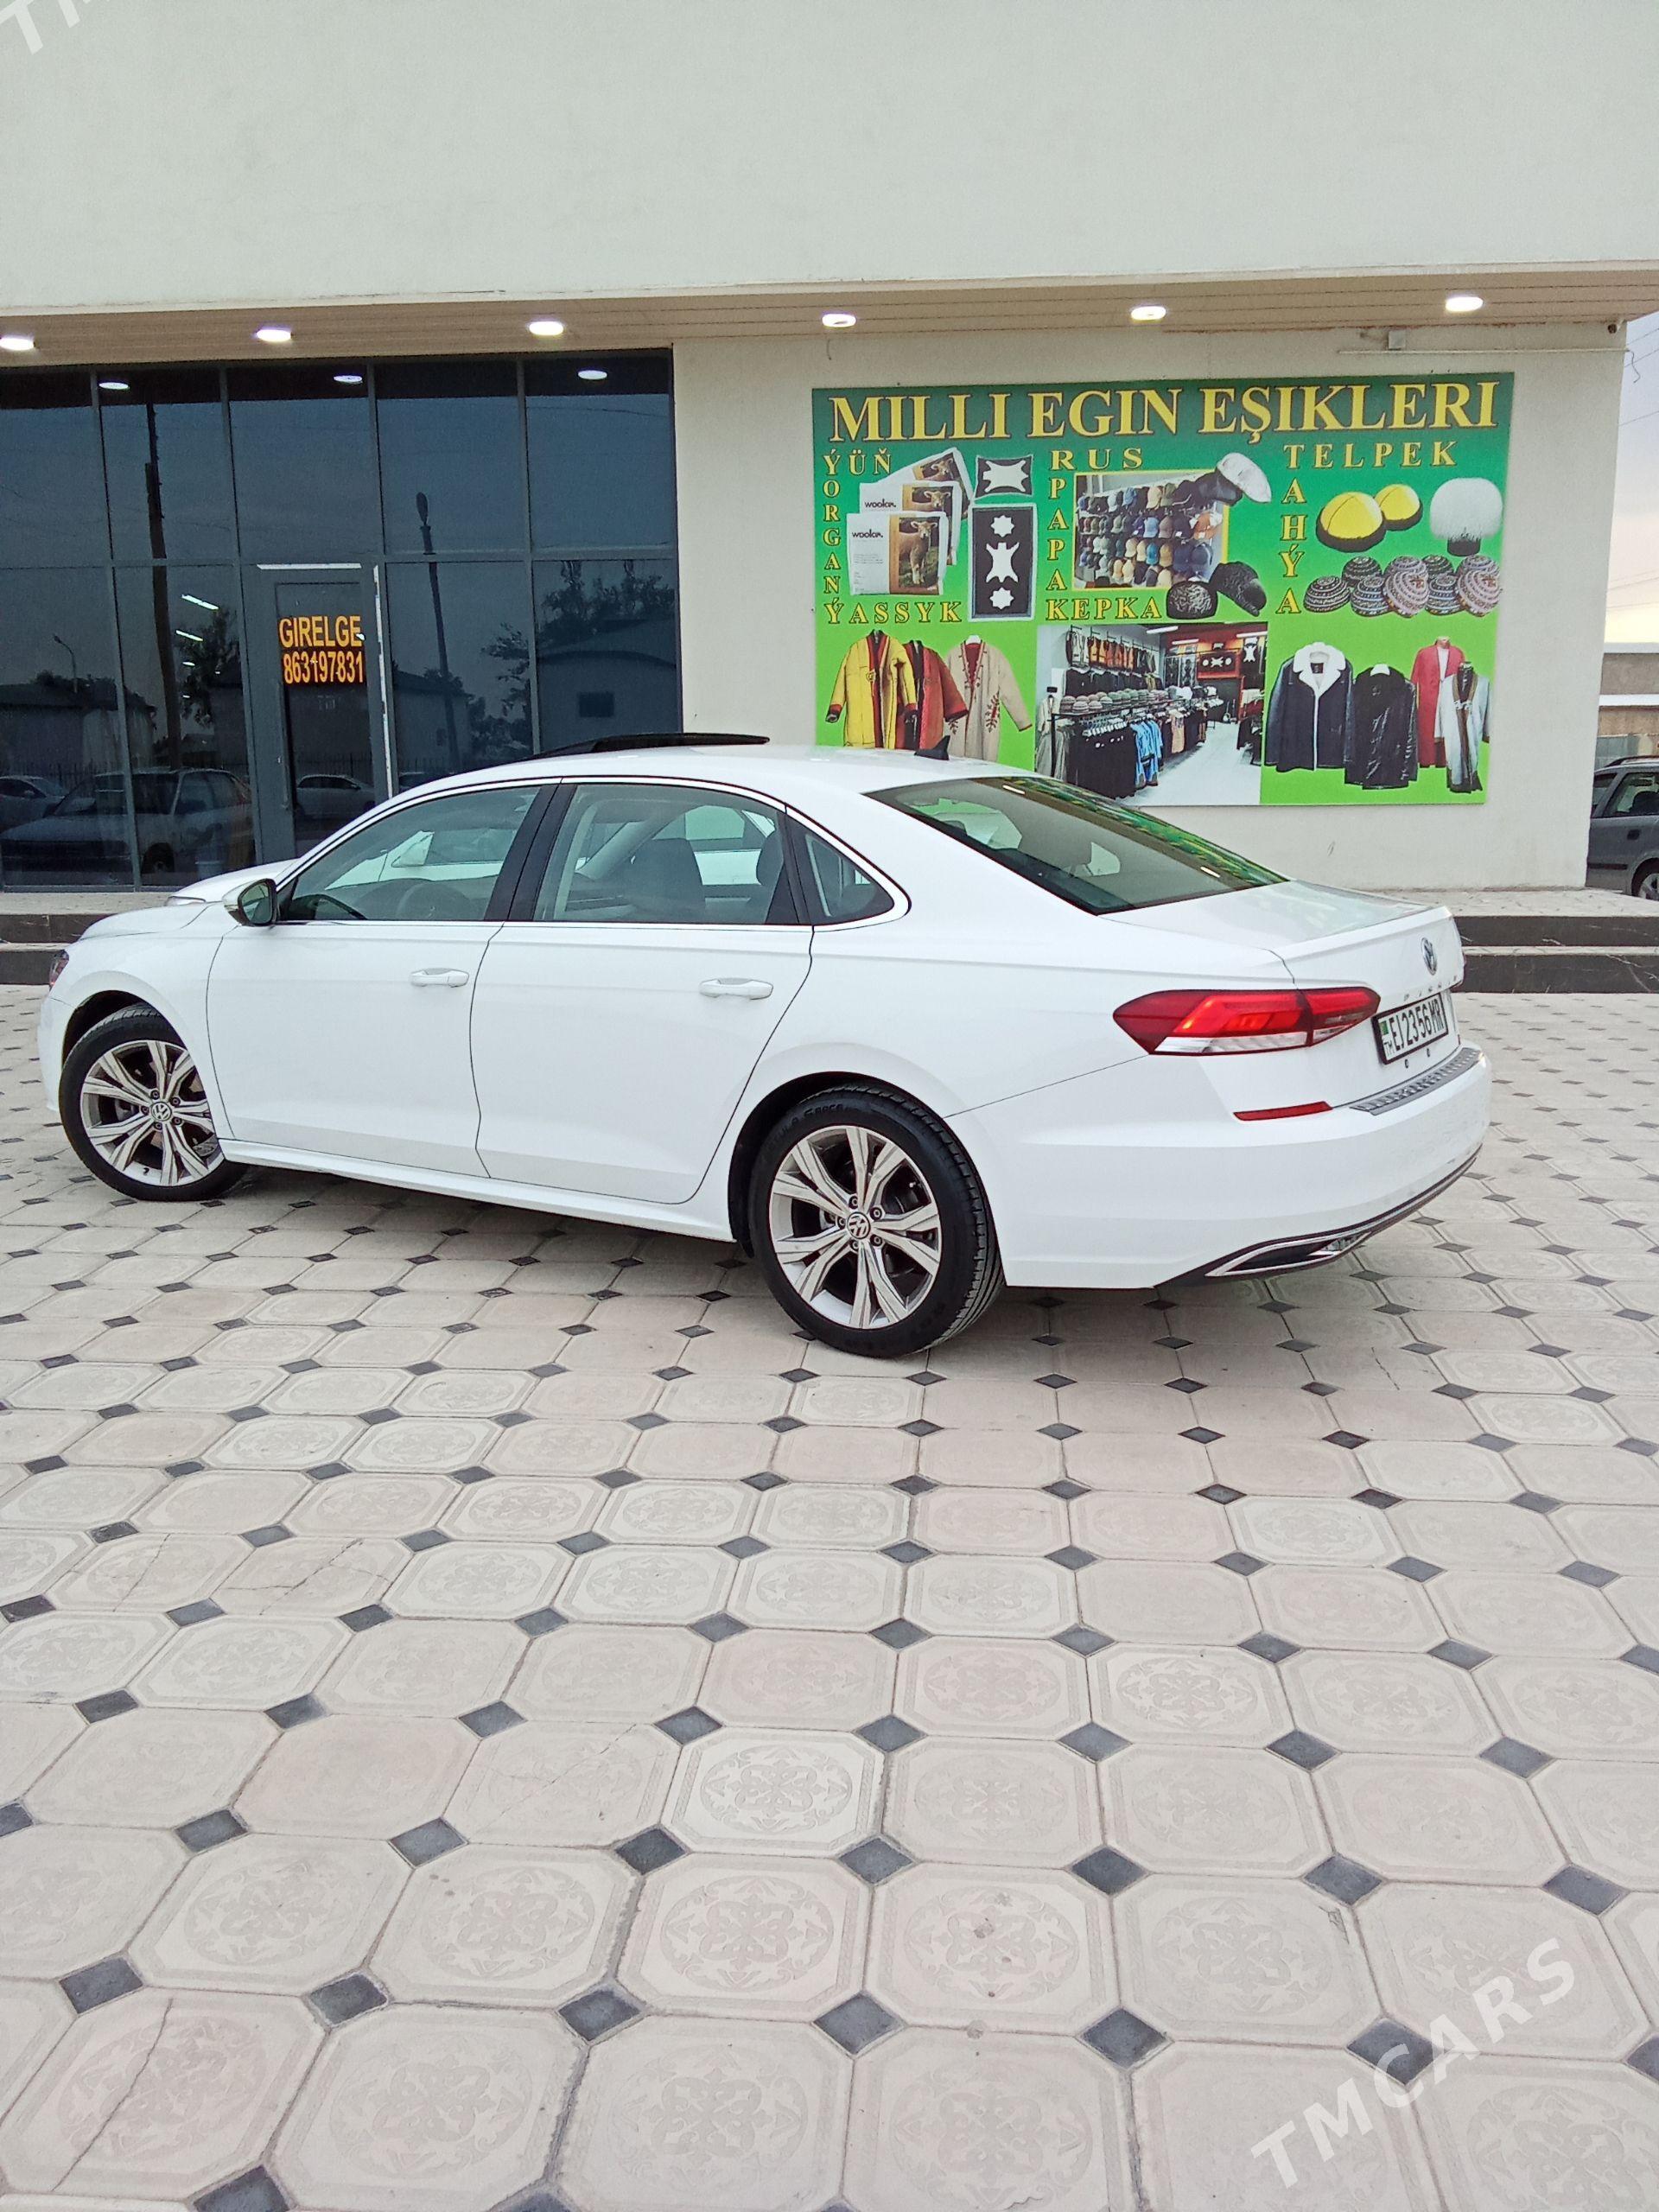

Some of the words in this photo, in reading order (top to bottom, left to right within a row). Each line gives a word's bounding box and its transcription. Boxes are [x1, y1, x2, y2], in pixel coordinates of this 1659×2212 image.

[828, 392, 1012, 442] MILLI
[1027, 388, 1182, 438] EGIN
[1198, 381, 1500, 444] EŞIKLERI
[1051, 447, 1143, 471] RUS
[1282, 441, 1458, 469] TELPEK
[824, 601, 963, 625] ÝASSYK
[1046, 597, 1162, 621] KEPKA
[279, 615, 363, 648] GIRELGE
[283, 651, 364, 684] 863197831
